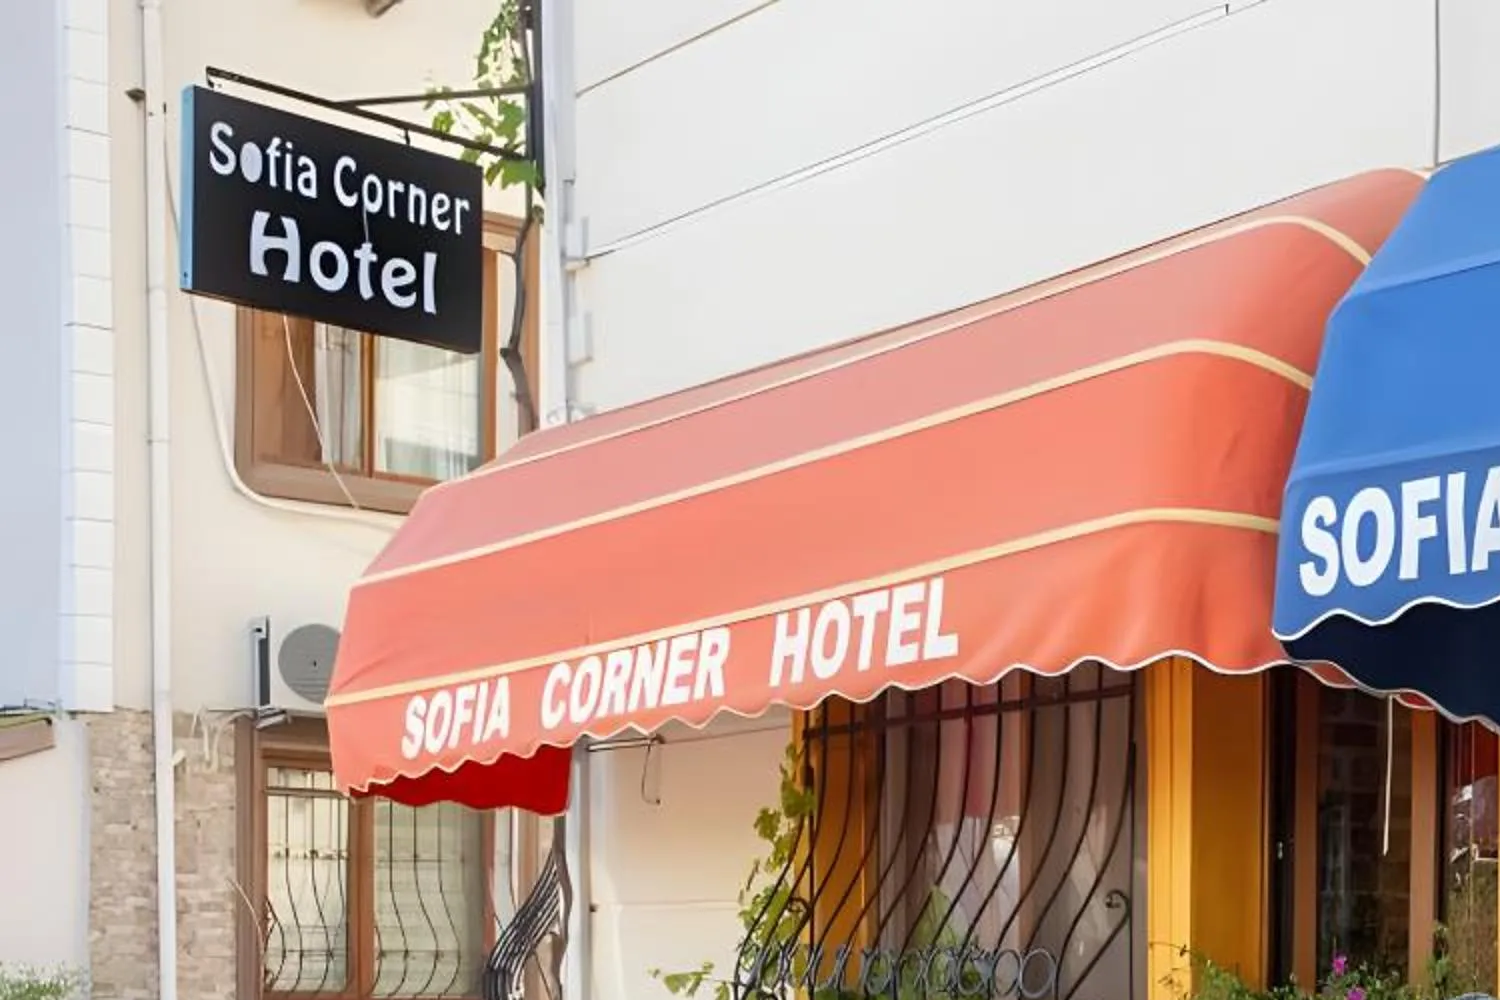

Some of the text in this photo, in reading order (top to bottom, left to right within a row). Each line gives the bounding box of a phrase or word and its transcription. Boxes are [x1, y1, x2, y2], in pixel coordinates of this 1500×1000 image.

[209, 121, 471, 235] Sofia Corner
[250, 210, 437, 315] Hotel
[402, 577, 959, 760] SOFIA CORNER HOTEL
